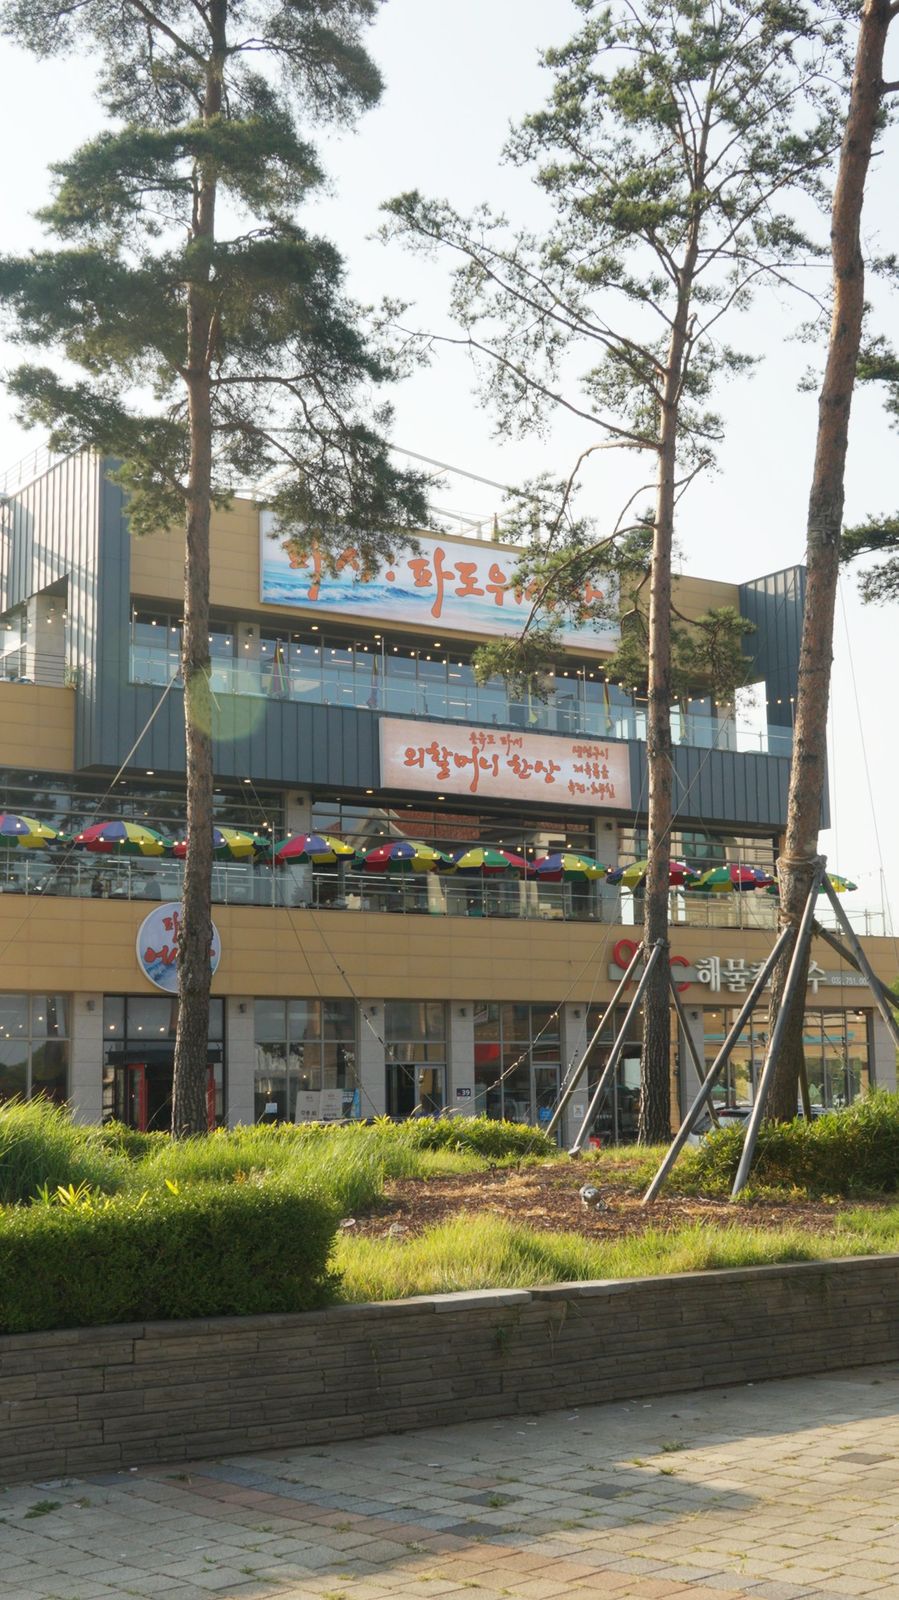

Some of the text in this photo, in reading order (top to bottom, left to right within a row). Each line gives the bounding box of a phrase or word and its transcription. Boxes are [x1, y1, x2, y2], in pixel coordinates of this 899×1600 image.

[403, 741, 562, 793] 외할머니 한상
[694, 955, 827, 995] 해물수
